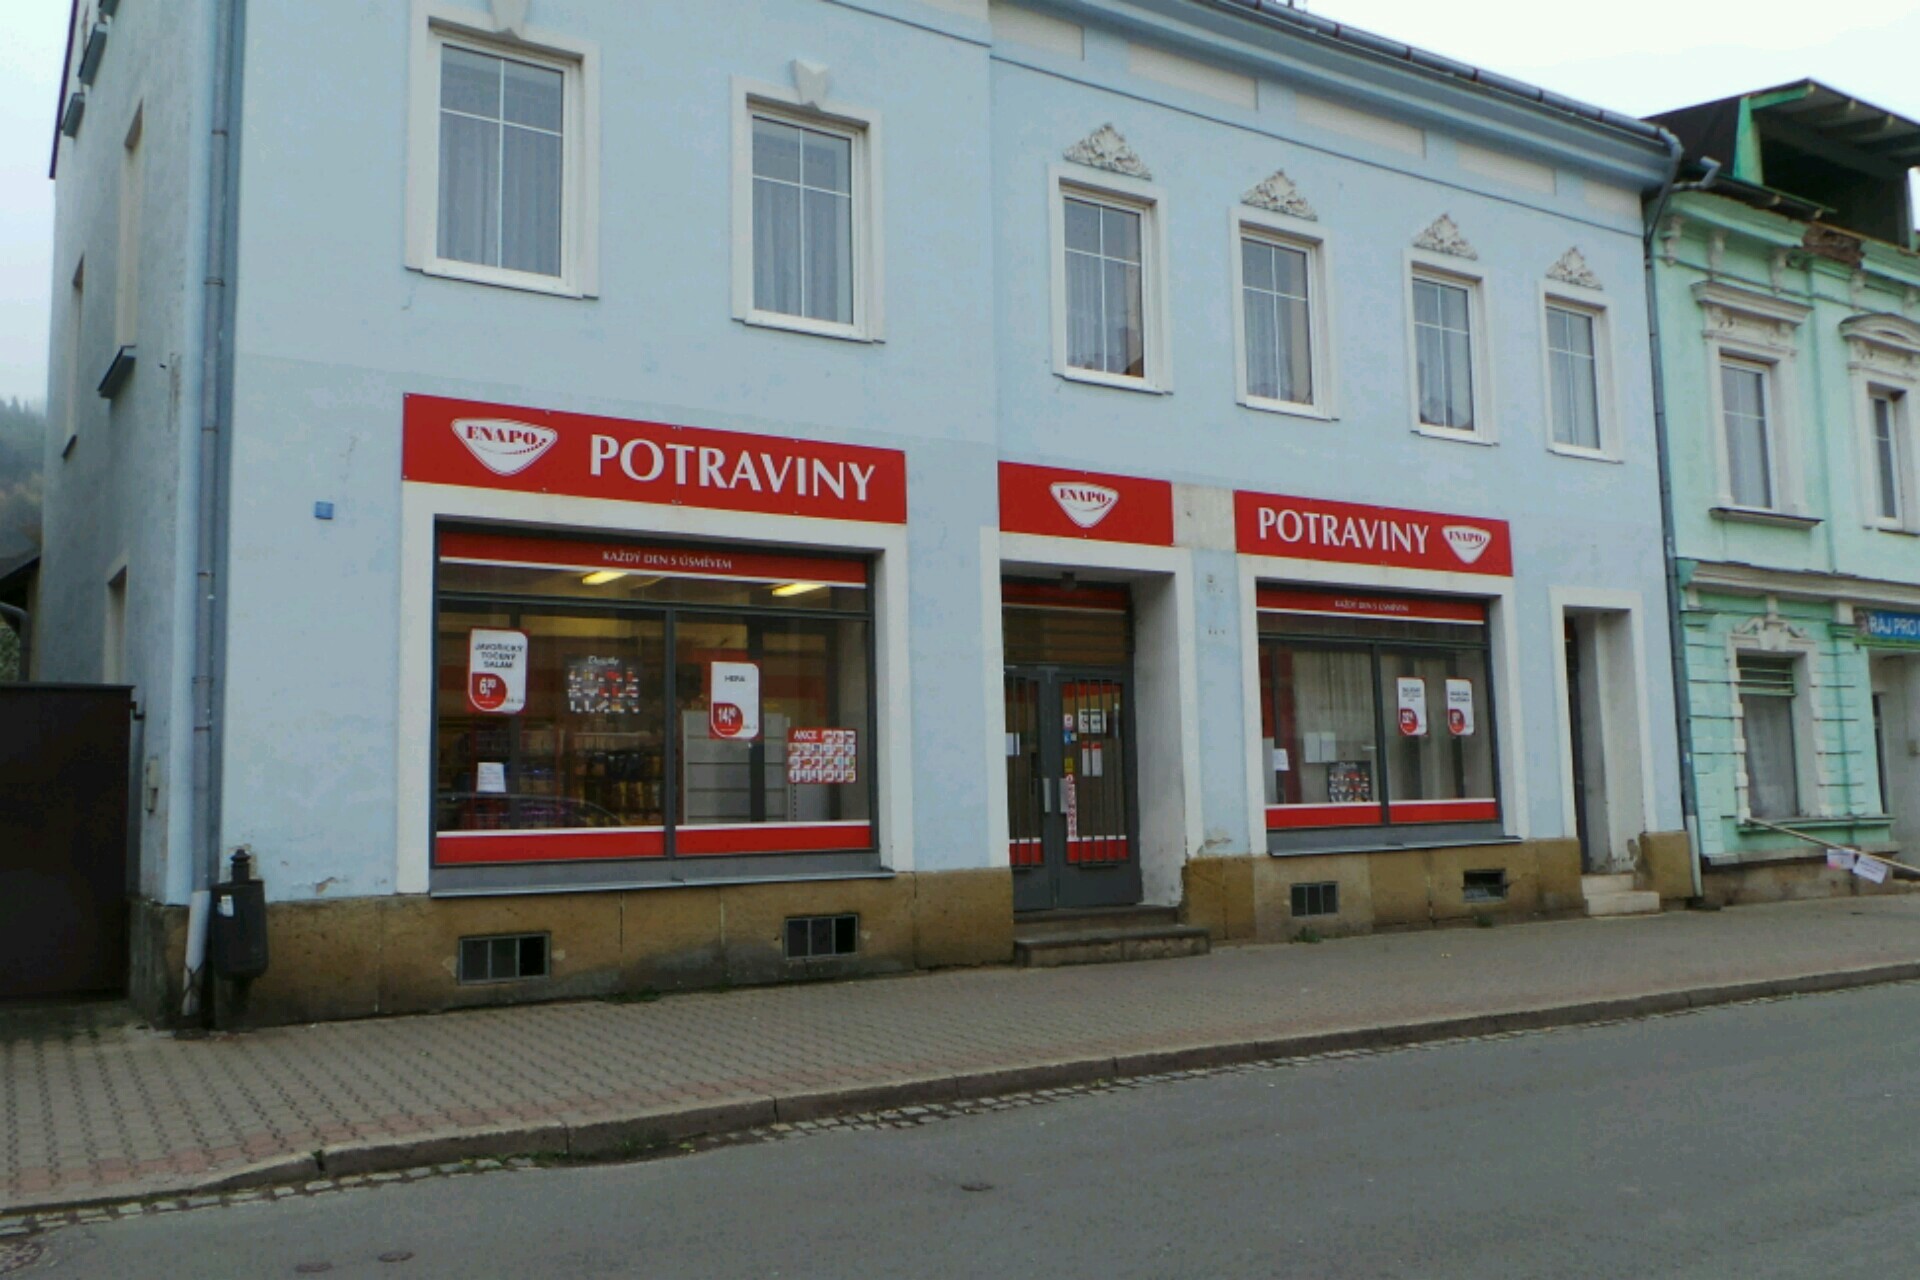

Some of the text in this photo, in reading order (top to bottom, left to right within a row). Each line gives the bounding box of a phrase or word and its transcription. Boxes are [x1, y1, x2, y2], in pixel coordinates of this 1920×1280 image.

[466, 425, 538, 445] ENAPO
[590, 434, 876, 502] POTRAVINY
[1060, 488, 1106, 503] ENAPO
[1258, 507, 1429, 555] POTRAVINY
[644, 553, 668, 565] DEN
